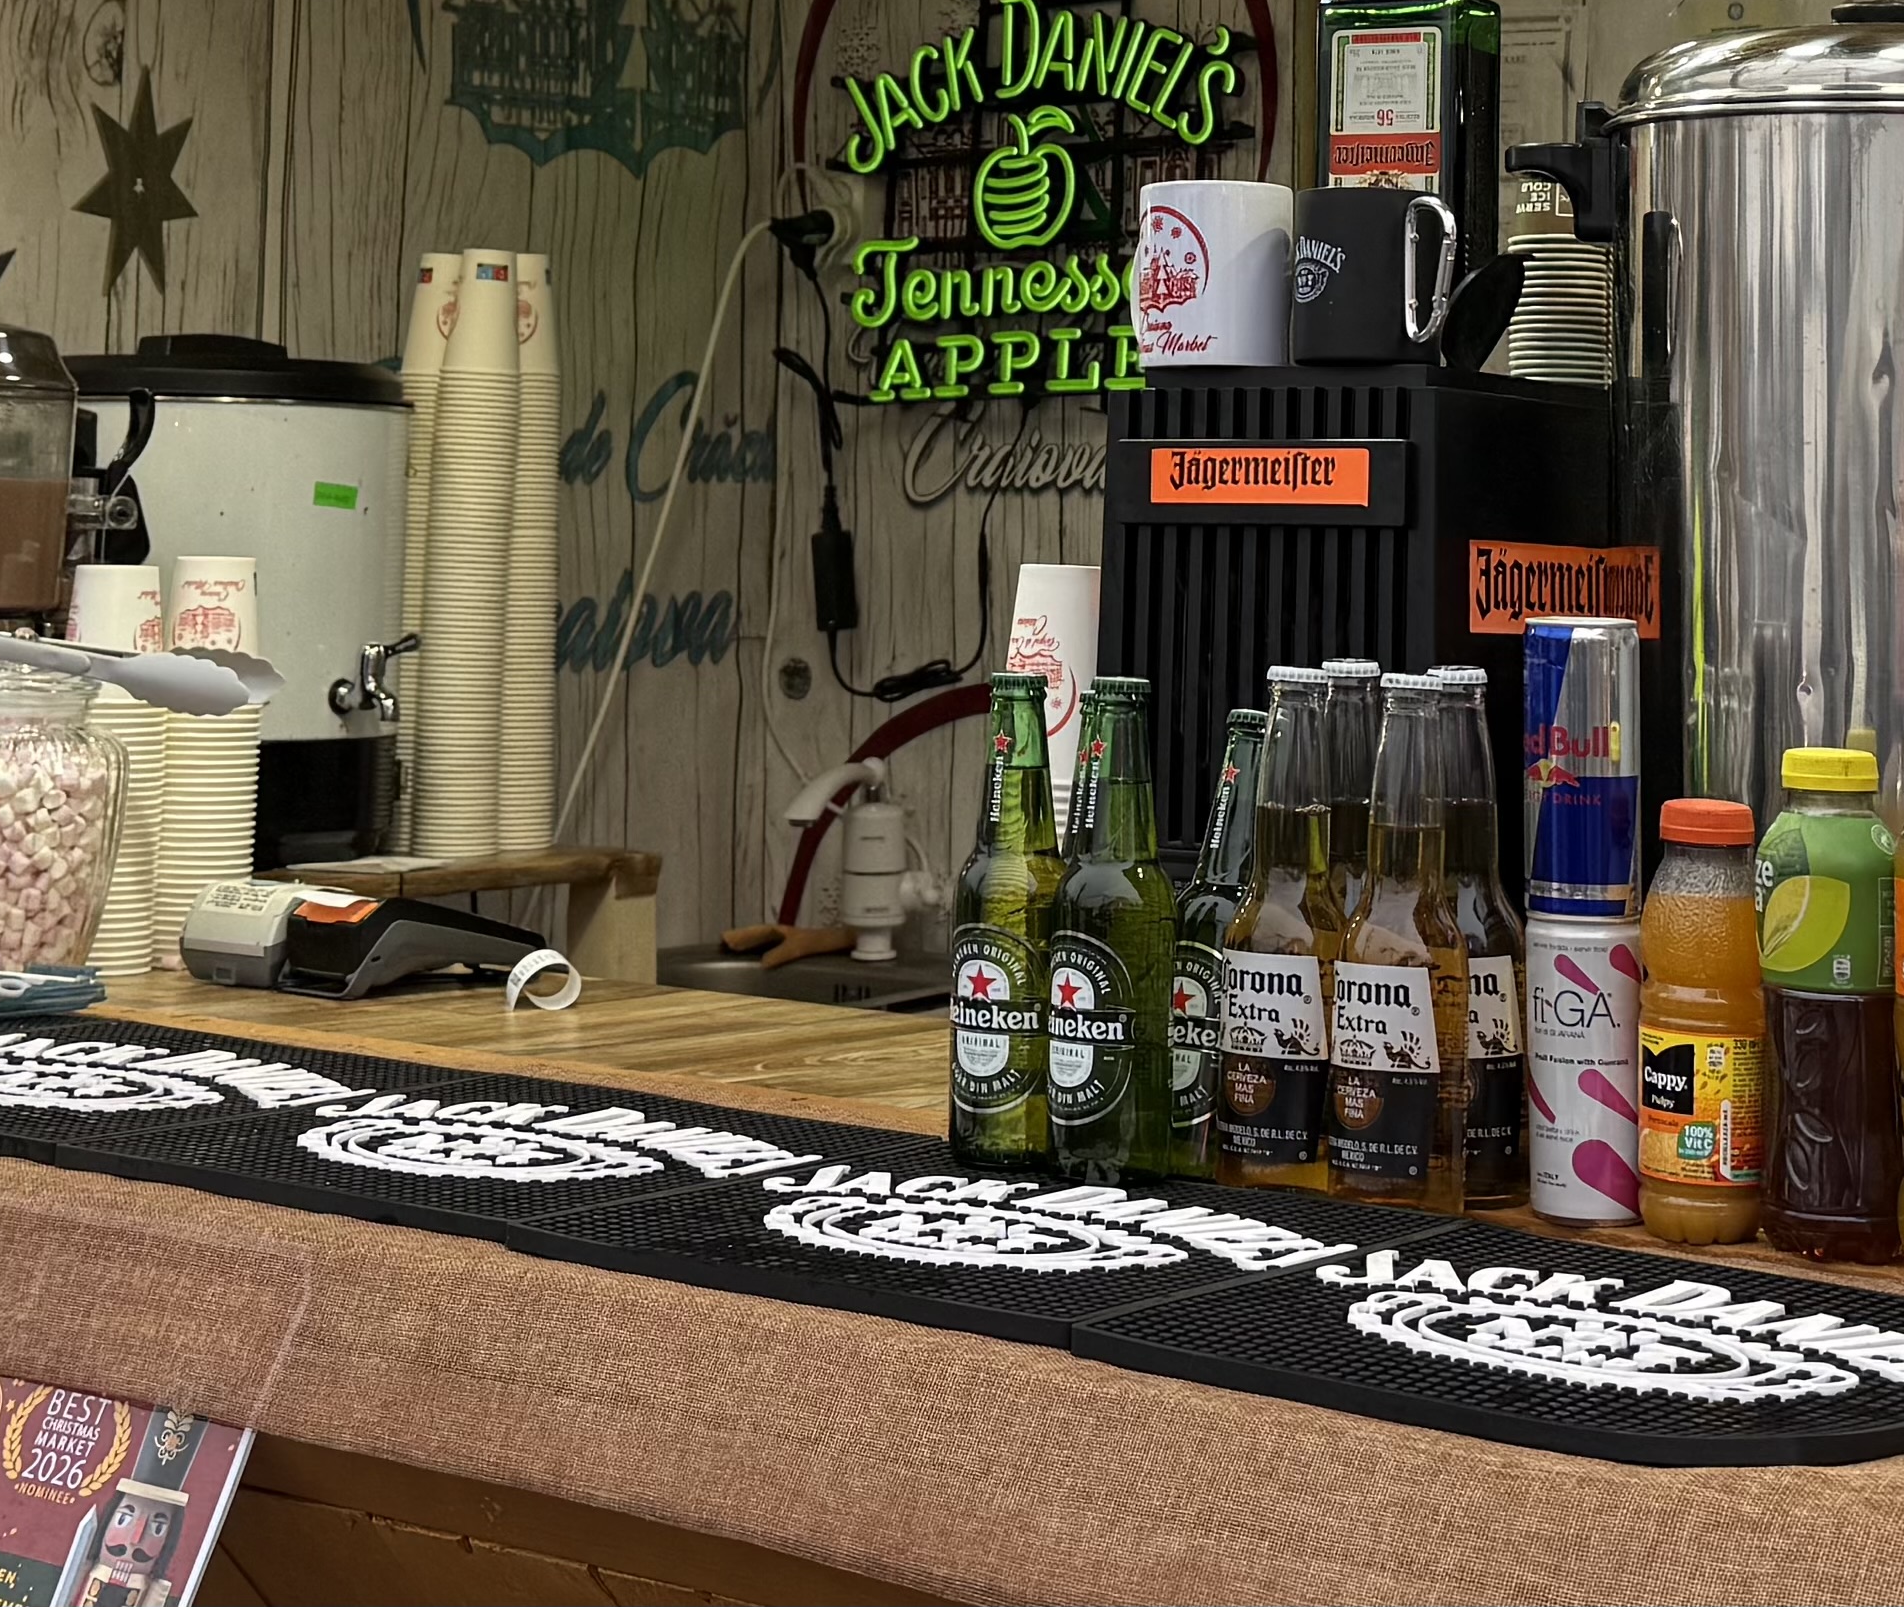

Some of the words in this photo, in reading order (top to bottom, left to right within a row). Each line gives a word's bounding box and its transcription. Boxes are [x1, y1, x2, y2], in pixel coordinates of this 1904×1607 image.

[846, 25, 984, 174] JACK
[1377, 109, 1394, 126] 56
[1530, 192, 1550, 201] ICE
[870, 326, 1146, 402] APPLE
[1550, 726, 1609, 758] Bull
[1085, 761, 1099, 828] Heineken
[1210, 785, 1230, 849] Heineken
[1228, 995, 1280, 1023] Extra
[1337, 1006, 1387, 1035] Extra
[1227, 1070, 1267, 1085] CERVEZA
[1337, 1084, 1377, 1098] CERVEZA
[1645, 1066, 1686, 1091] Cappy
[1684, 1125, 1713, 1138] 100%
[1685, 1137, 1702, 1149] Vit
[1703, 1138, 1713, 1149] C
[1316, 1250, 1625, 1303] JACK
[47, 1389, 113, 1425] BEST
[43, 1416, 101, 1439] CHRISTMAS
[34, 1431, 95, 1457] MARKET
[22, 1449, 87, 1489] 2026
